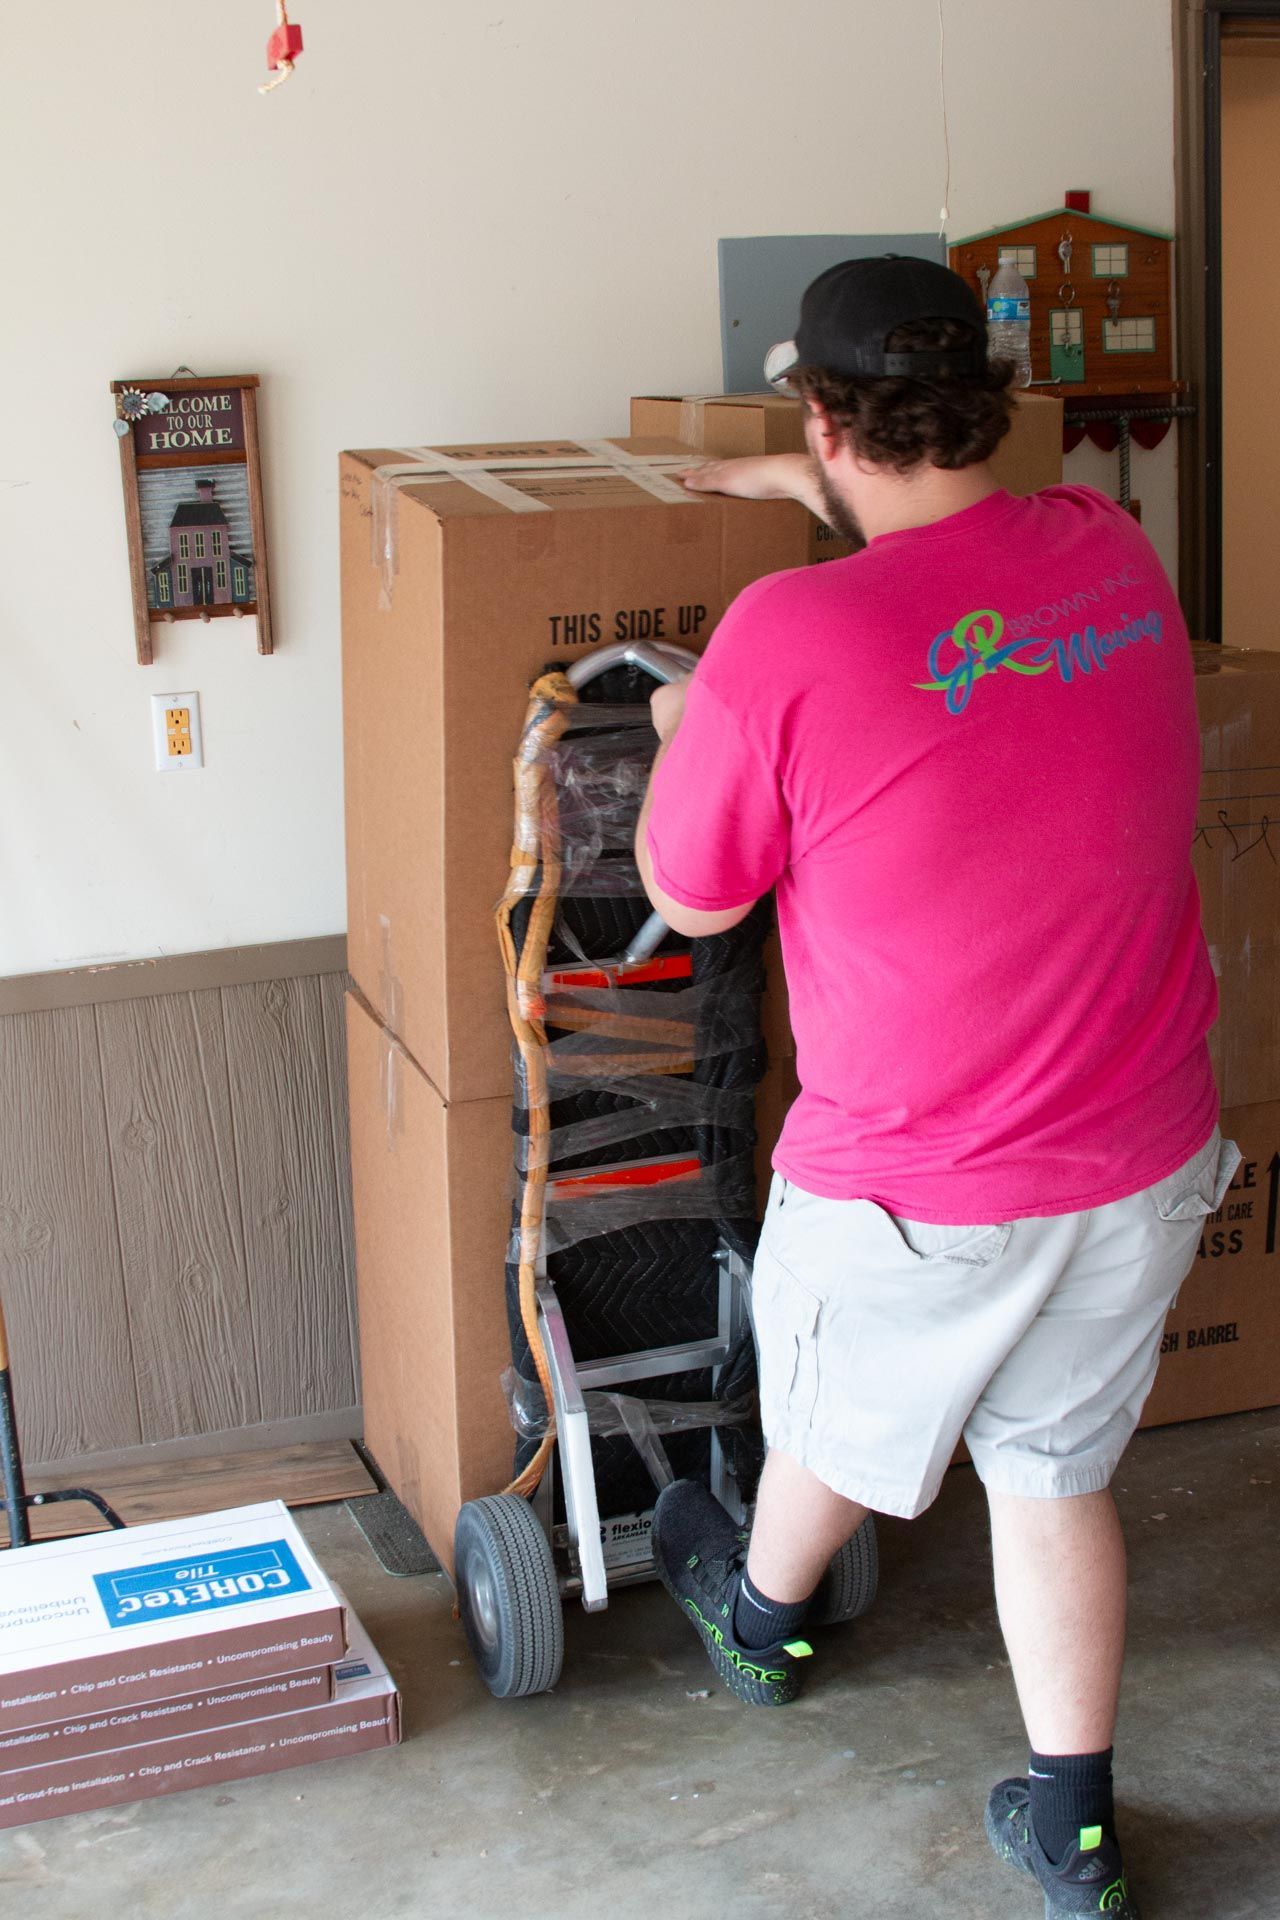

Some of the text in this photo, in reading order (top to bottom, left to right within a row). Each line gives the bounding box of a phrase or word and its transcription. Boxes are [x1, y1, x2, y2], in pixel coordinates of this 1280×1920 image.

[149, 428, 233, 450] HOME
[166, 414, 213, 431] TO OUR
[548, 604, 707, 646] THIS SIDE UP
[1006, 587, 1101, 638] BROWN
[1030, 610, 1162, 683] Moving
[1228, 1201, 1254, 1221] CARE
[1196, 1228, 1243, 1259] ASS
[1160, 1322, 1240, 1354] SH BARREL
[175, 1564, 220, 1580] Tile
[1, 1633, 334, 1708] Installation Chip and Crack Resistance Uncompromising Beauty
[0, 1675, 322, 1748] nstallation Chip and Crack Resistance Uncompromising Beauty
[16, 1785, 70, 1802] Grout-Free
[72, 1774, 126, 1791] Installation
[138, 1766, 163, 1778] Chip
[164, 1761, 182, 1772] and
[184, 1754, 213, 1768] Crack
[214, 1743, 266, 1761] Resistance
[279, 1723, 358, 1748] Uncompromising
[360, 1716, 392, 1731] Beauty
